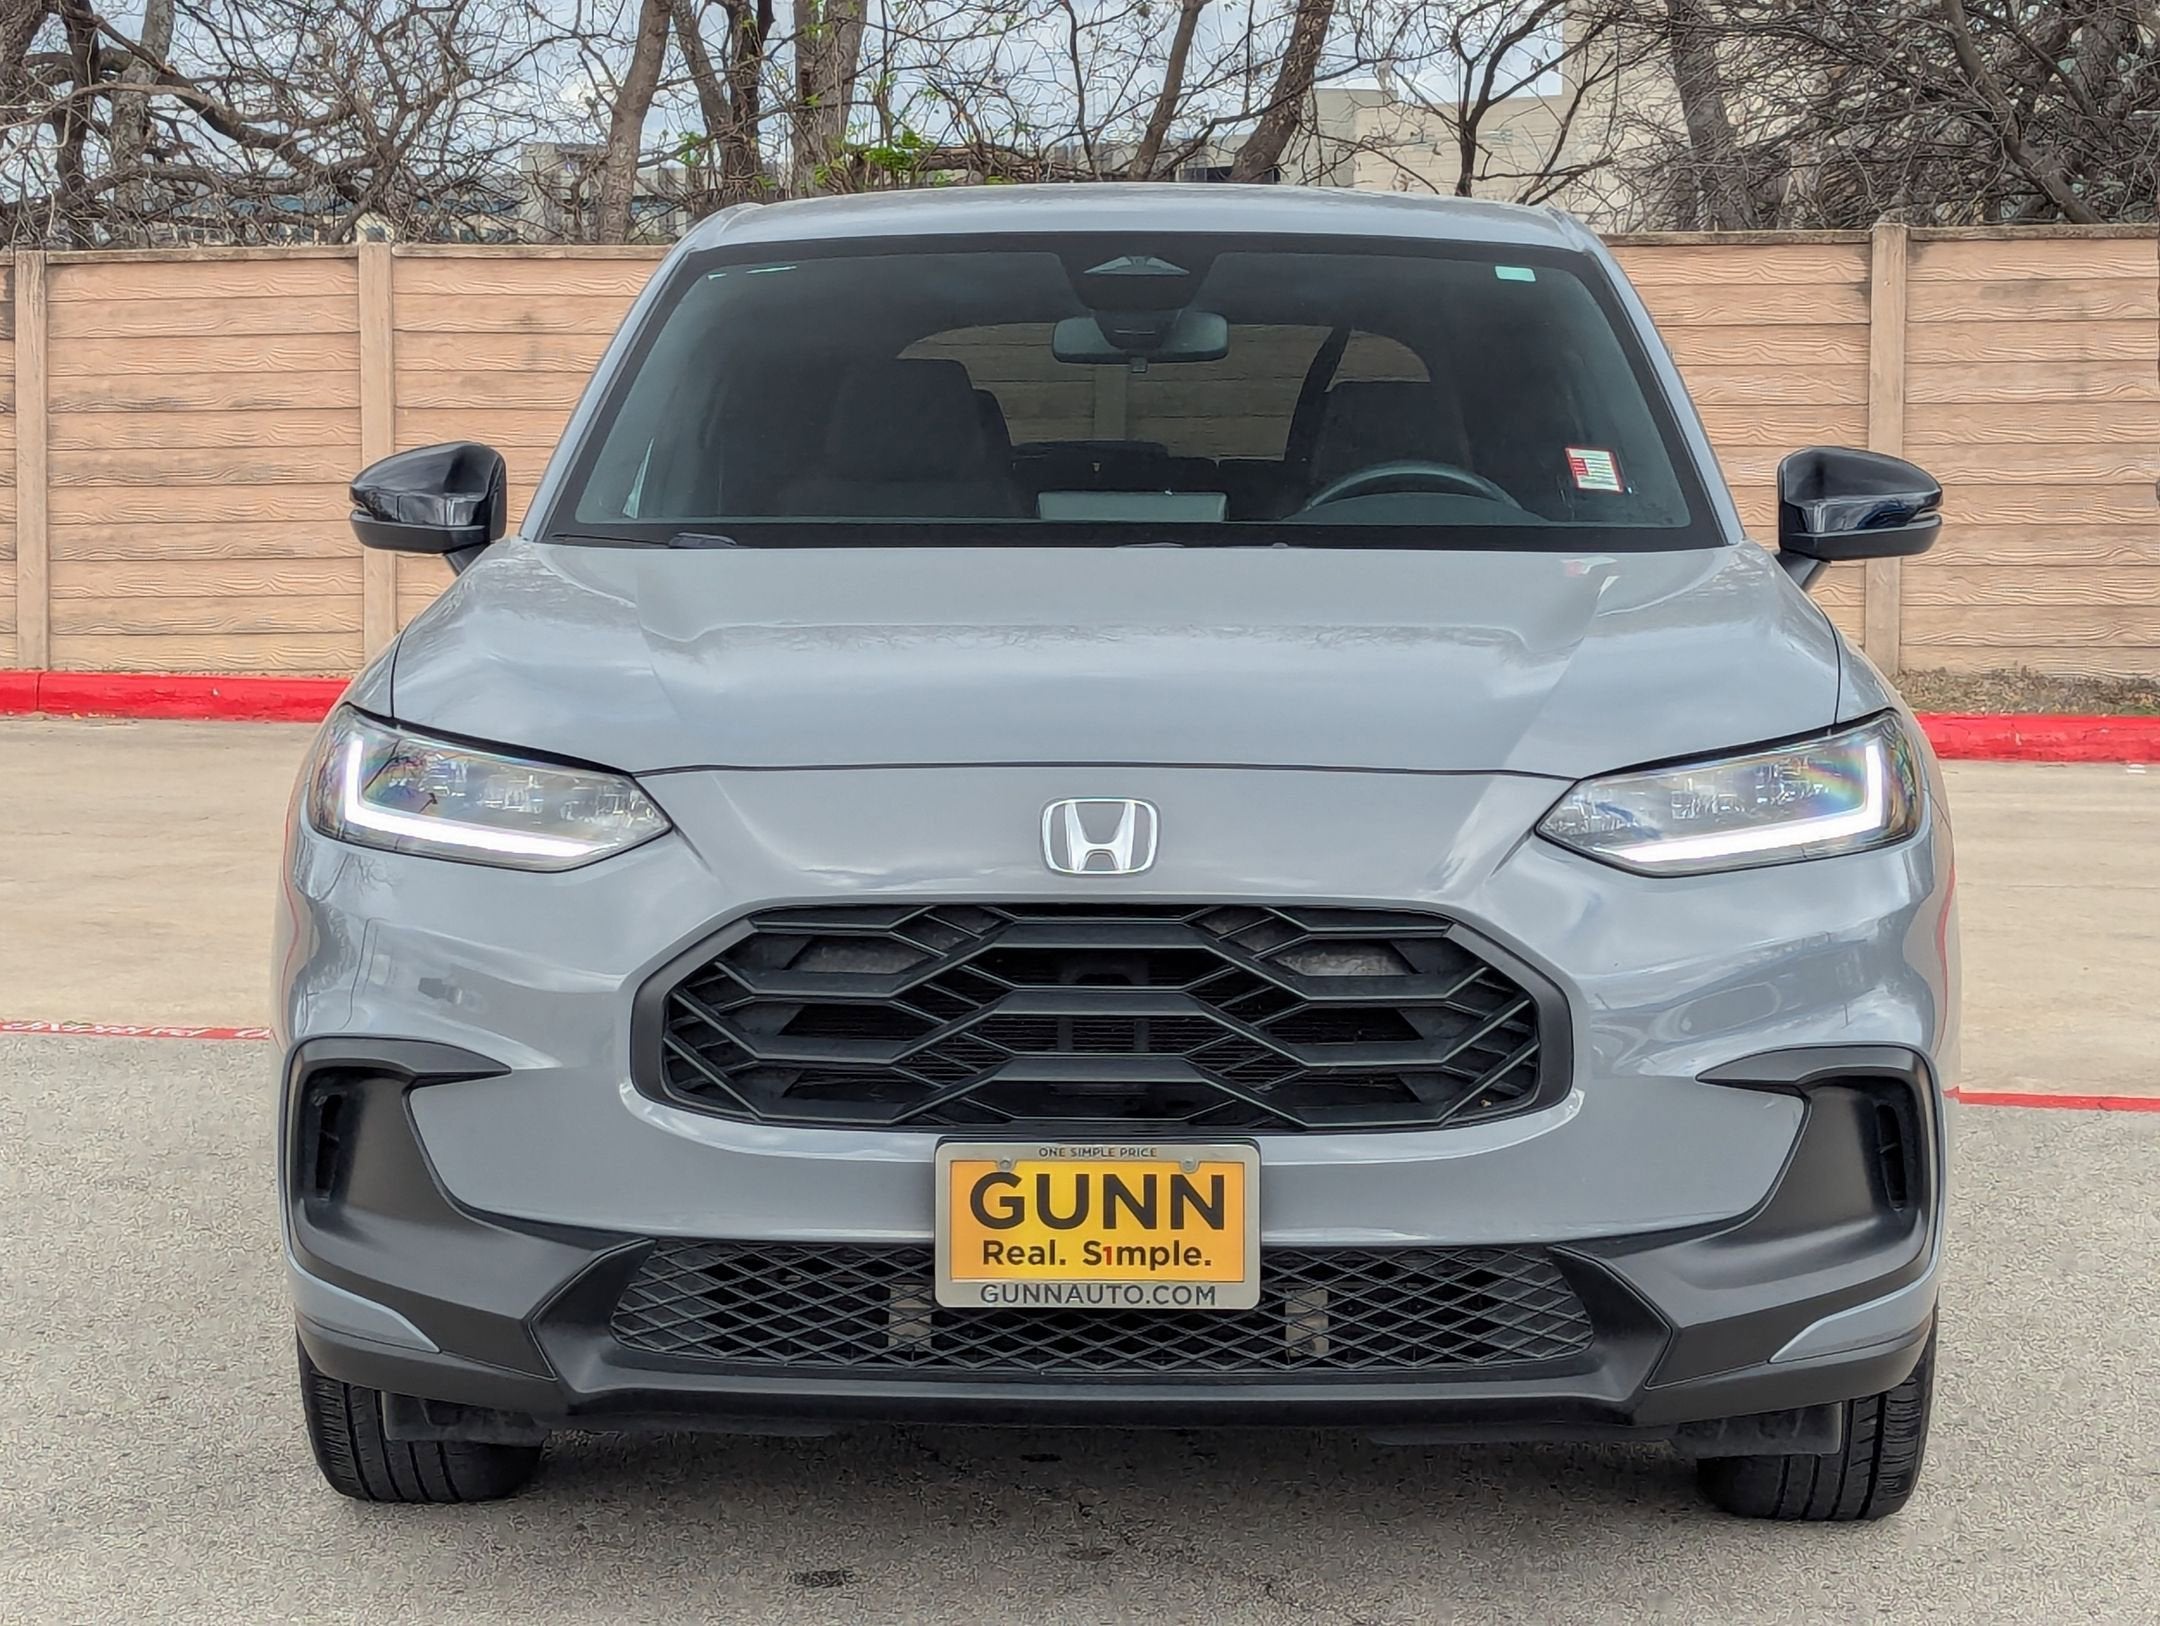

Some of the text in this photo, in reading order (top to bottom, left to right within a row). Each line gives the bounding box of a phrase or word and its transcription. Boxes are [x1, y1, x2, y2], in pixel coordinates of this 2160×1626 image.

[1038, 1147, 1157, 1158] ONE SIMPLE PRICE
[970, 1171, 1225, 1230] GUNN
[982, 1240, 1067, 1266] Real.
[980, 1284, 1216, 1306] GUNNAUTO.COM
